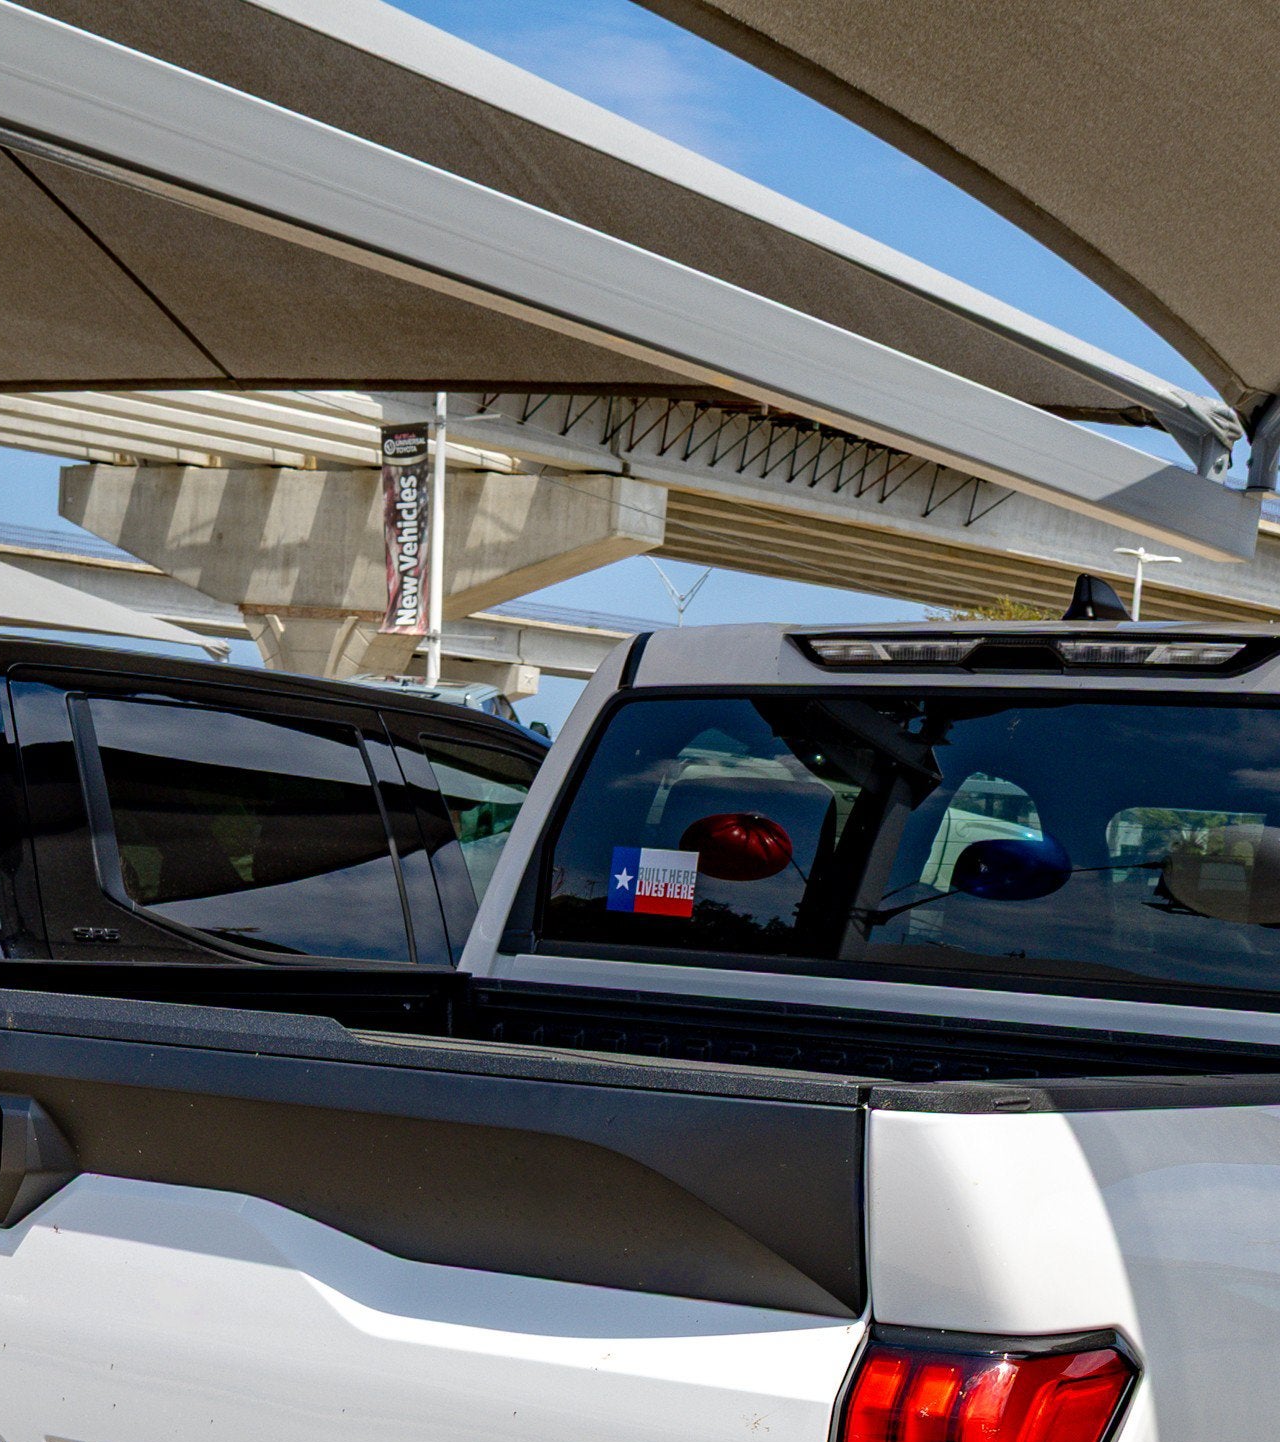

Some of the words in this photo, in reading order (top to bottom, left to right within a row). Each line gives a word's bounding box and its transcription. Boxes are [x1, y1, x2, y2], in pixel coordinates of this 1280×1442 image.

[395, 474, 418, 573] Vehicles
[395, 575, 418, 626] New
[635, 880, 666, 898] LIVES
[666, 883, 695, 899] HERE
[638, 867, 669, 882] BUILT
[669, 869, 697, 885] HERE
